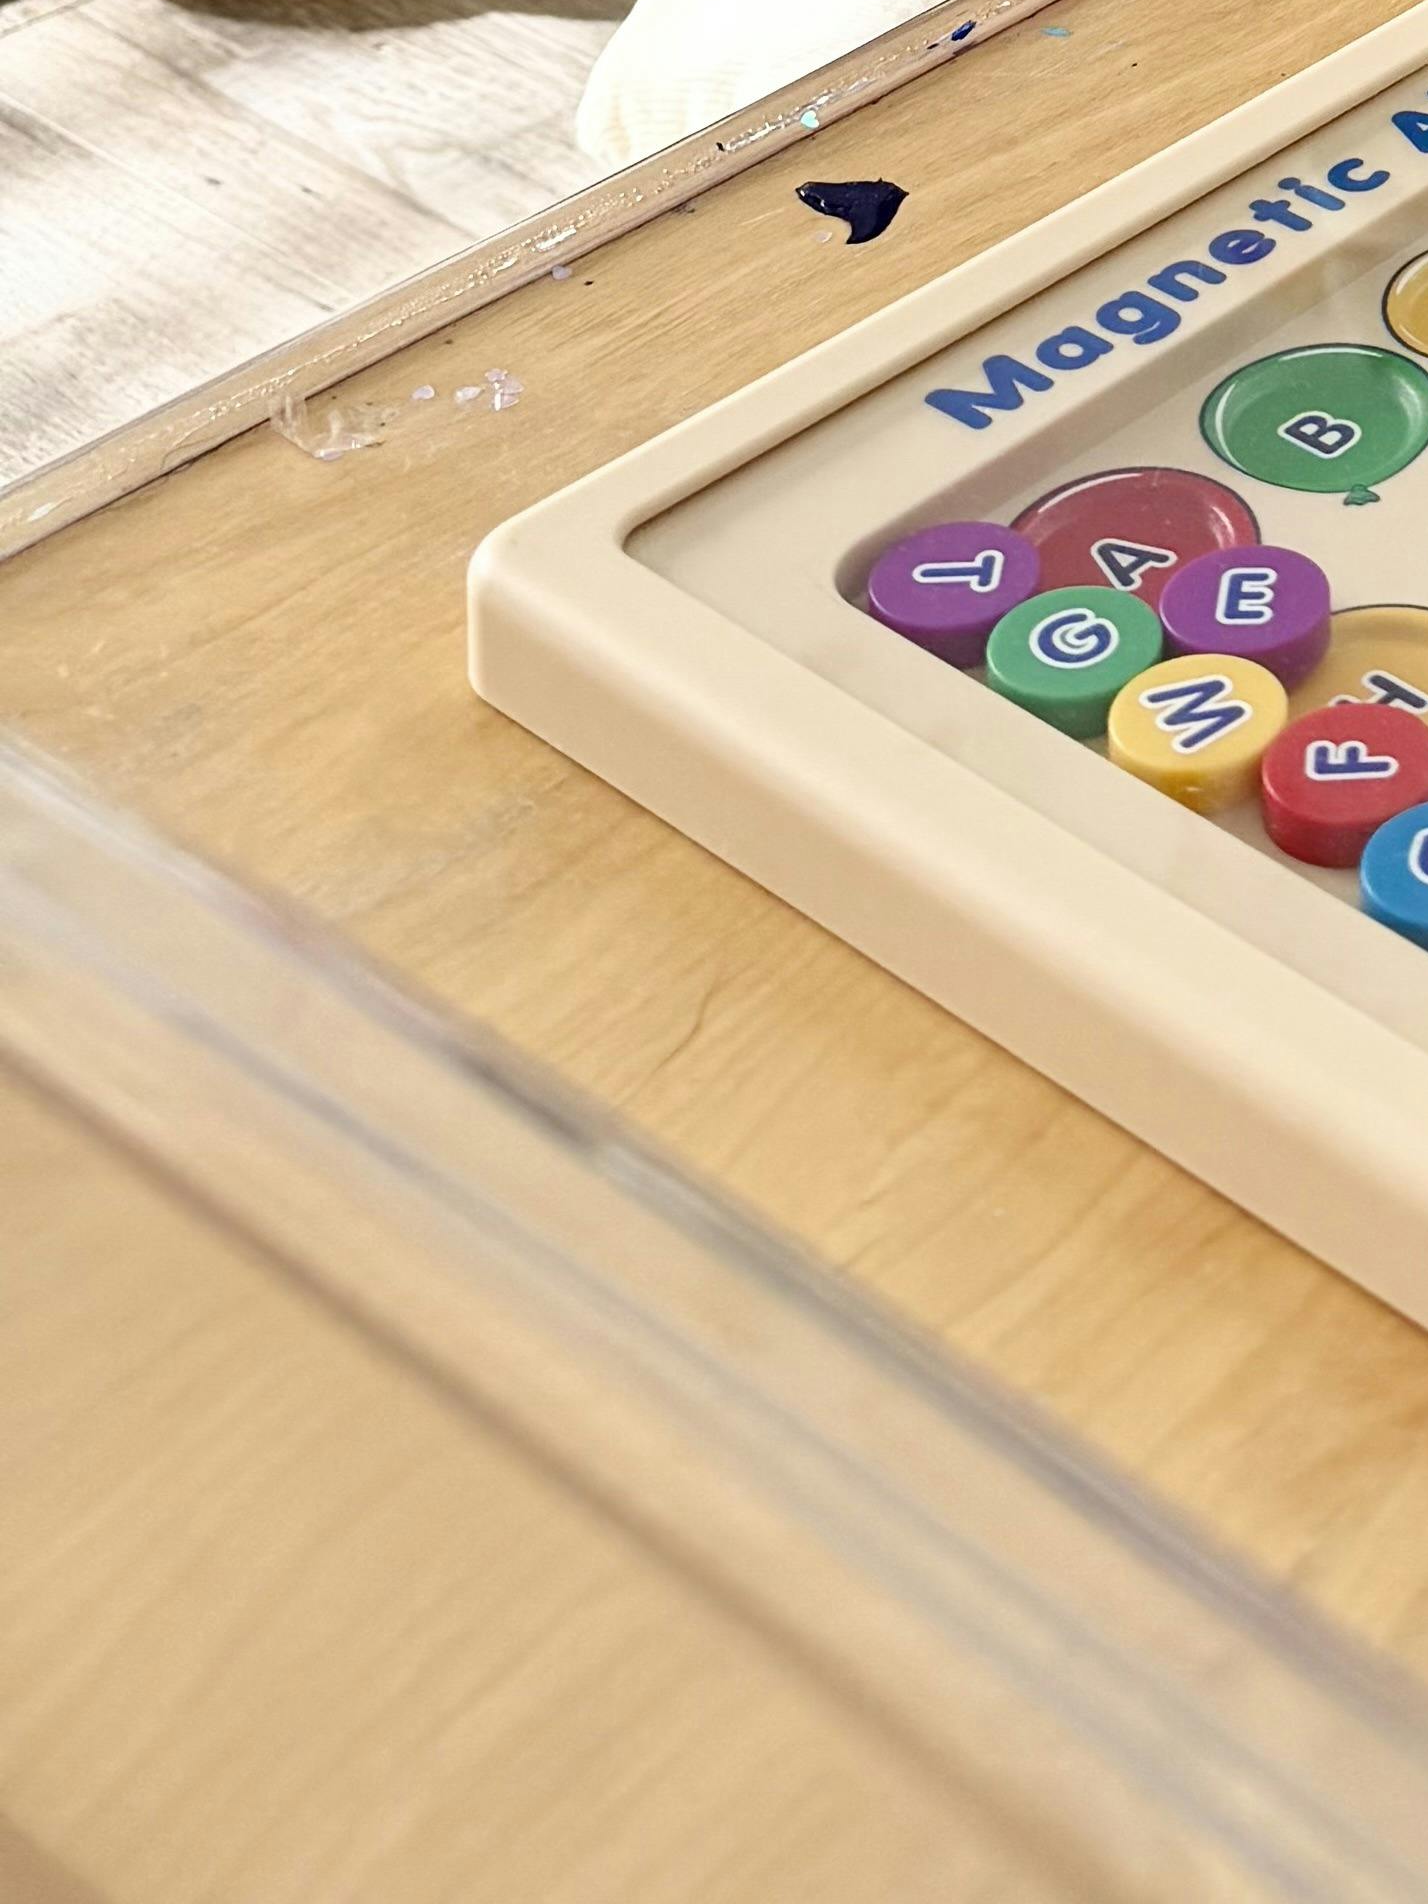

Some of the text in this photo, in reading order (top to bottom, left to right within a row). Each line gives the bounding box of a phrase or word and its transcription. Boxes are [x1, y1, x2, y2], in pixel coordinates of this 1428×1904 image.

[924, 155, 1391, 433] Magnetic
[1277, 409, 1362, 459] B
[911, 548, 1004, 592] T
[1090, 537, 1179, 591] A
[1217, 567, 1279, 626] E
[1028, 607, 1121, 670] G
[1305, 738, 1399, 782] F
